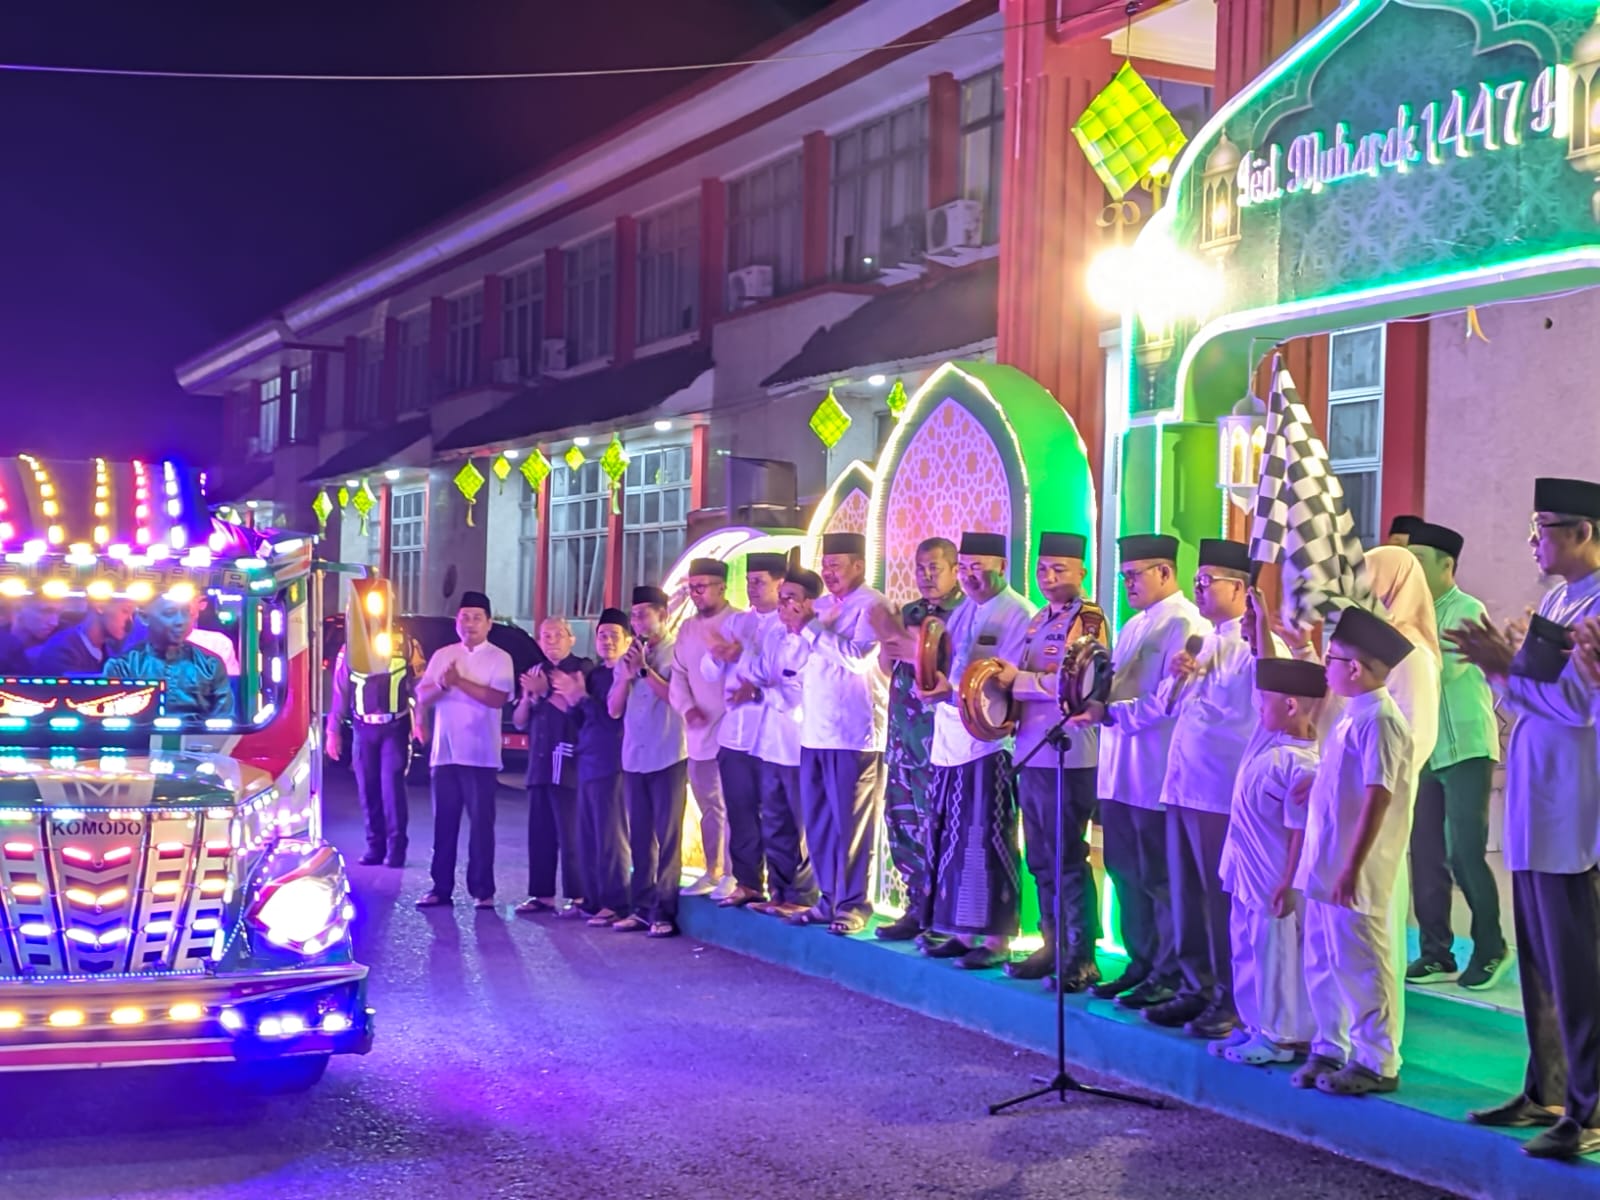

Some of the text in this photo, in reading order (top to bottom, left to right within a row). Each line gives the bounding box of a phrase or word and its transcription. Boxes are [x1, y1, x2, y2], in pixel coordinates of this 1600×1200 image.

[1287, 104, 1421, 194] Mubarak
[1421, 81, 1526, 165] 1447
[1531, 63, 1571, 139] H
[51, 821, 142, 836] KOMODO
